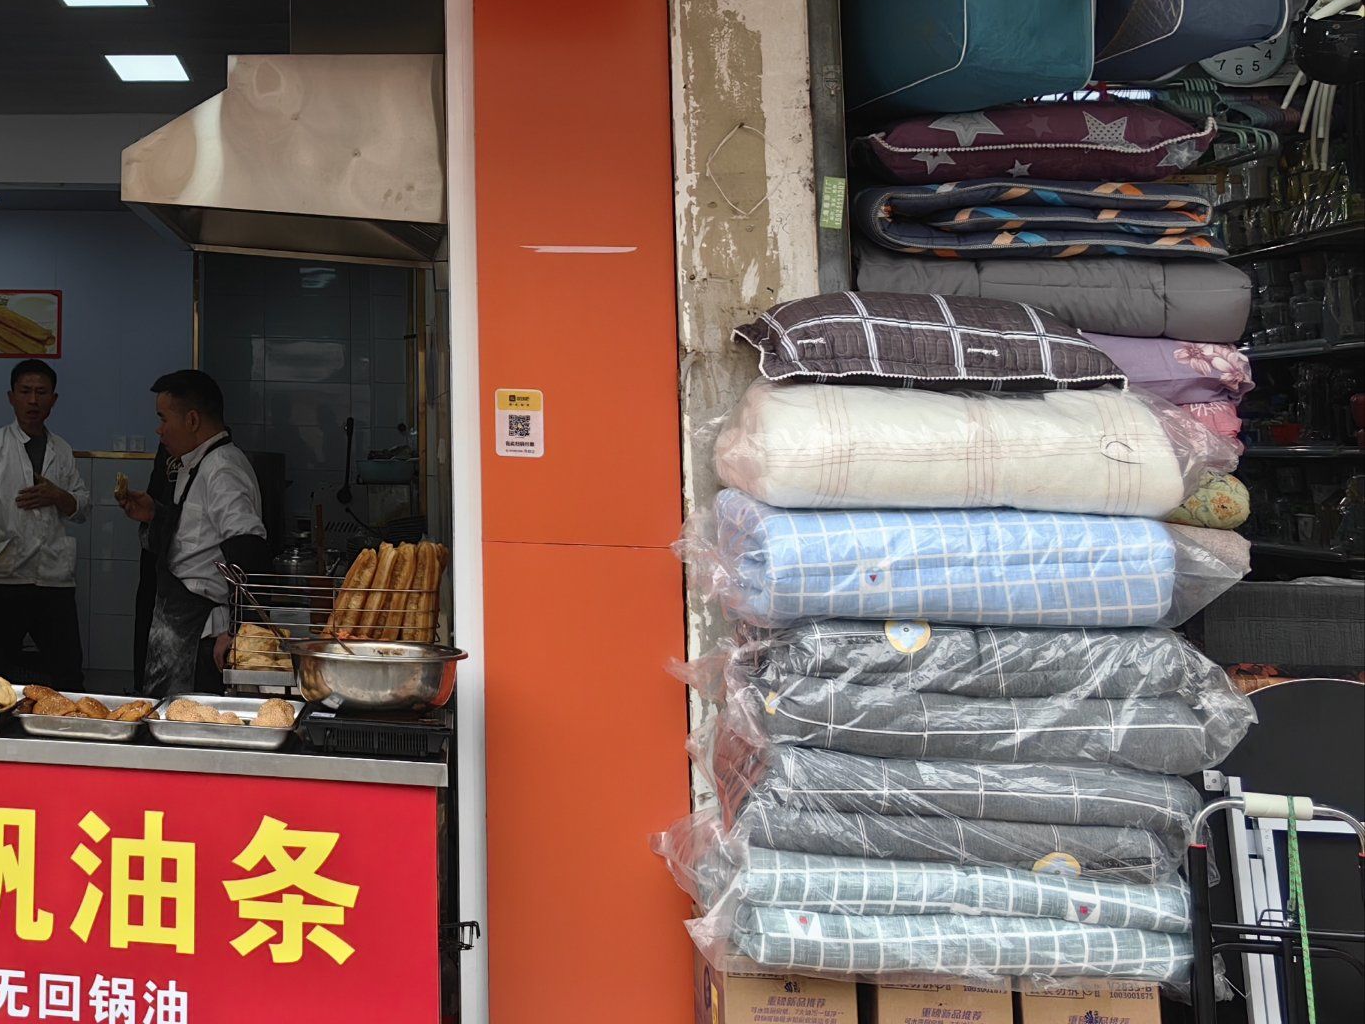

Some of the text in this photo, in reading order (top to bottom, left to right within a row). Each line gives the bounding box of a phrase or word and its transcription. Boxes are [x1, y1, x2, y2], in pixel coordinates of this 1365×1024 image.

[1264, 49, 1272, 60] 4
[1215, 59, 1226, 71] 7
[1235, 64, 1244, 75] 6
[1252, 60, 1260, 71] 5
